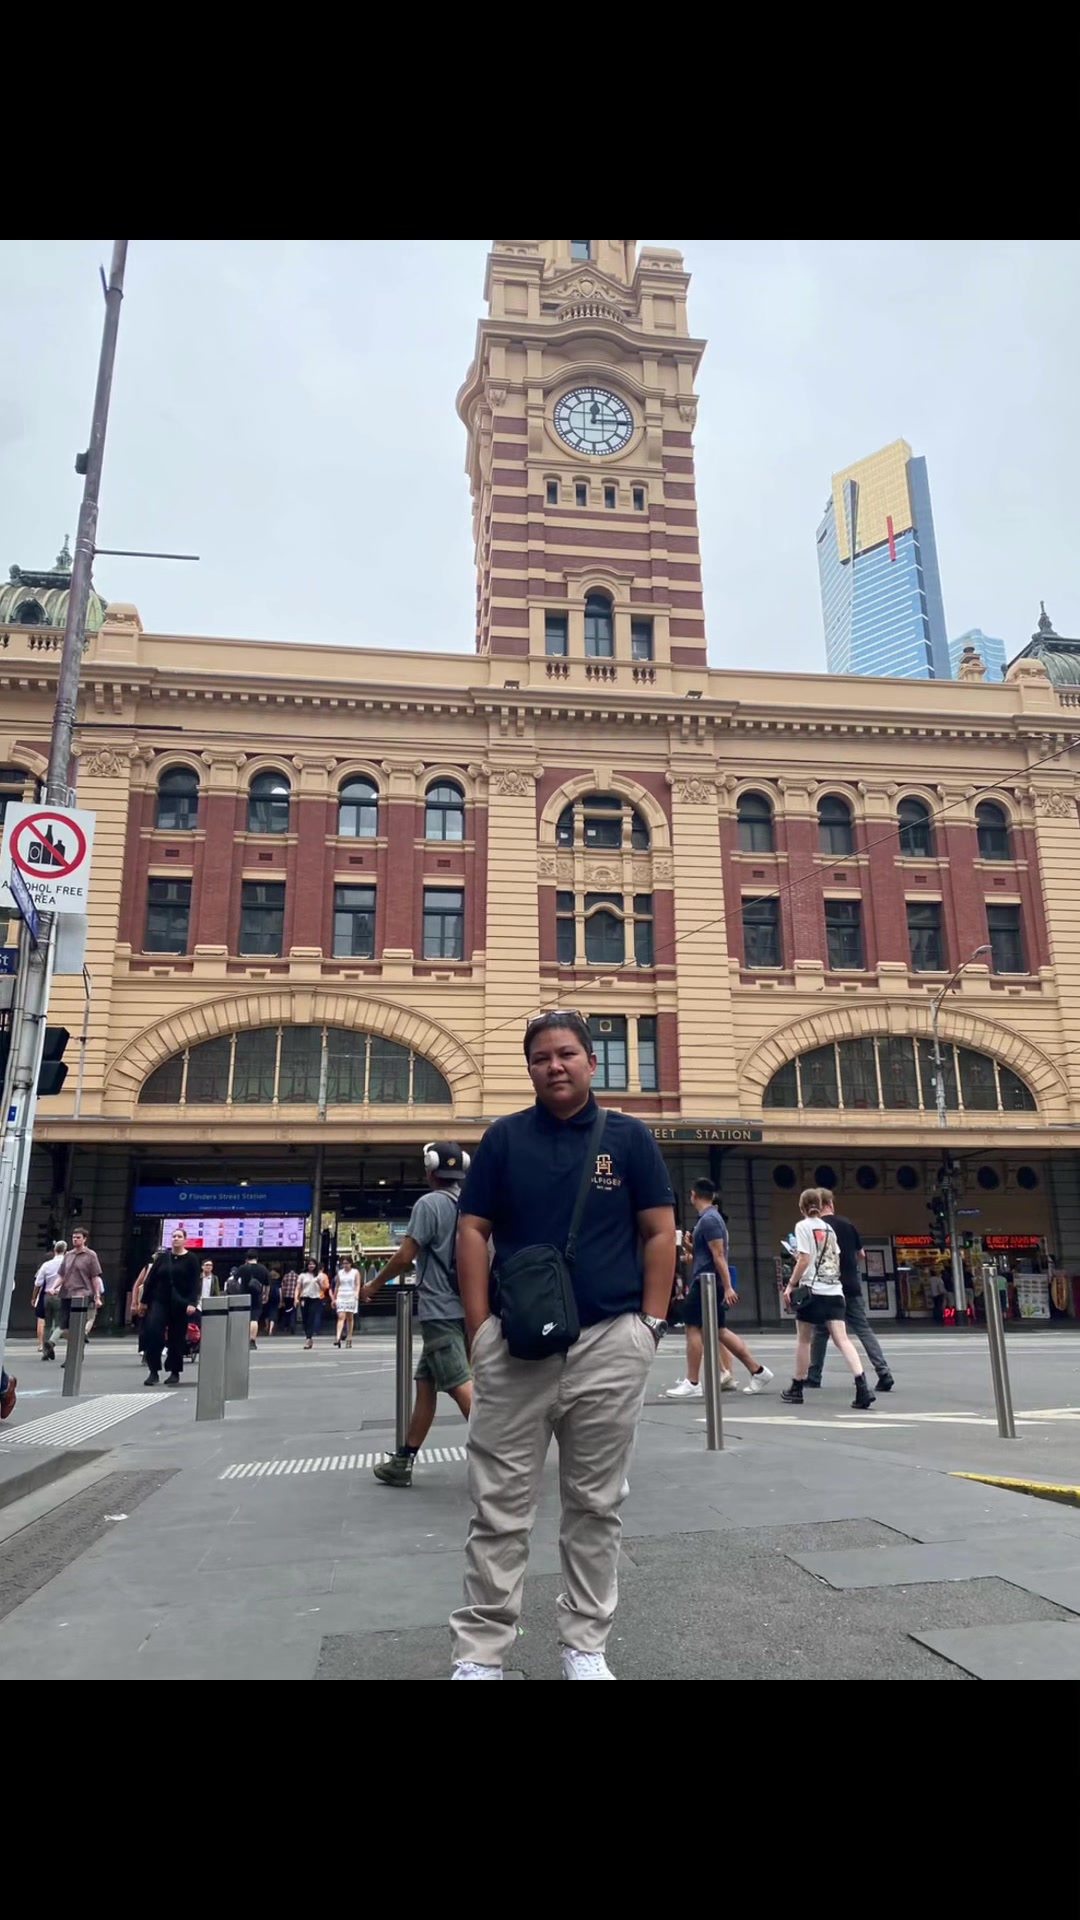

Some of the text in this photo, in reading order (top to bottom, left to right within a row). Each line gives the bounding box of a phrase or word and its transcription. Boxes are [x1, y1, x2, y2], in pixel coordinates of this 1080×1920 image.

[2, 880, 83, 897] AOHOL FREE
[33, 894, 56, 904] REA
[649, 1129, 751, 1140] EET STATION
[189, 1192, 267, 1200] Flinders Street Station
